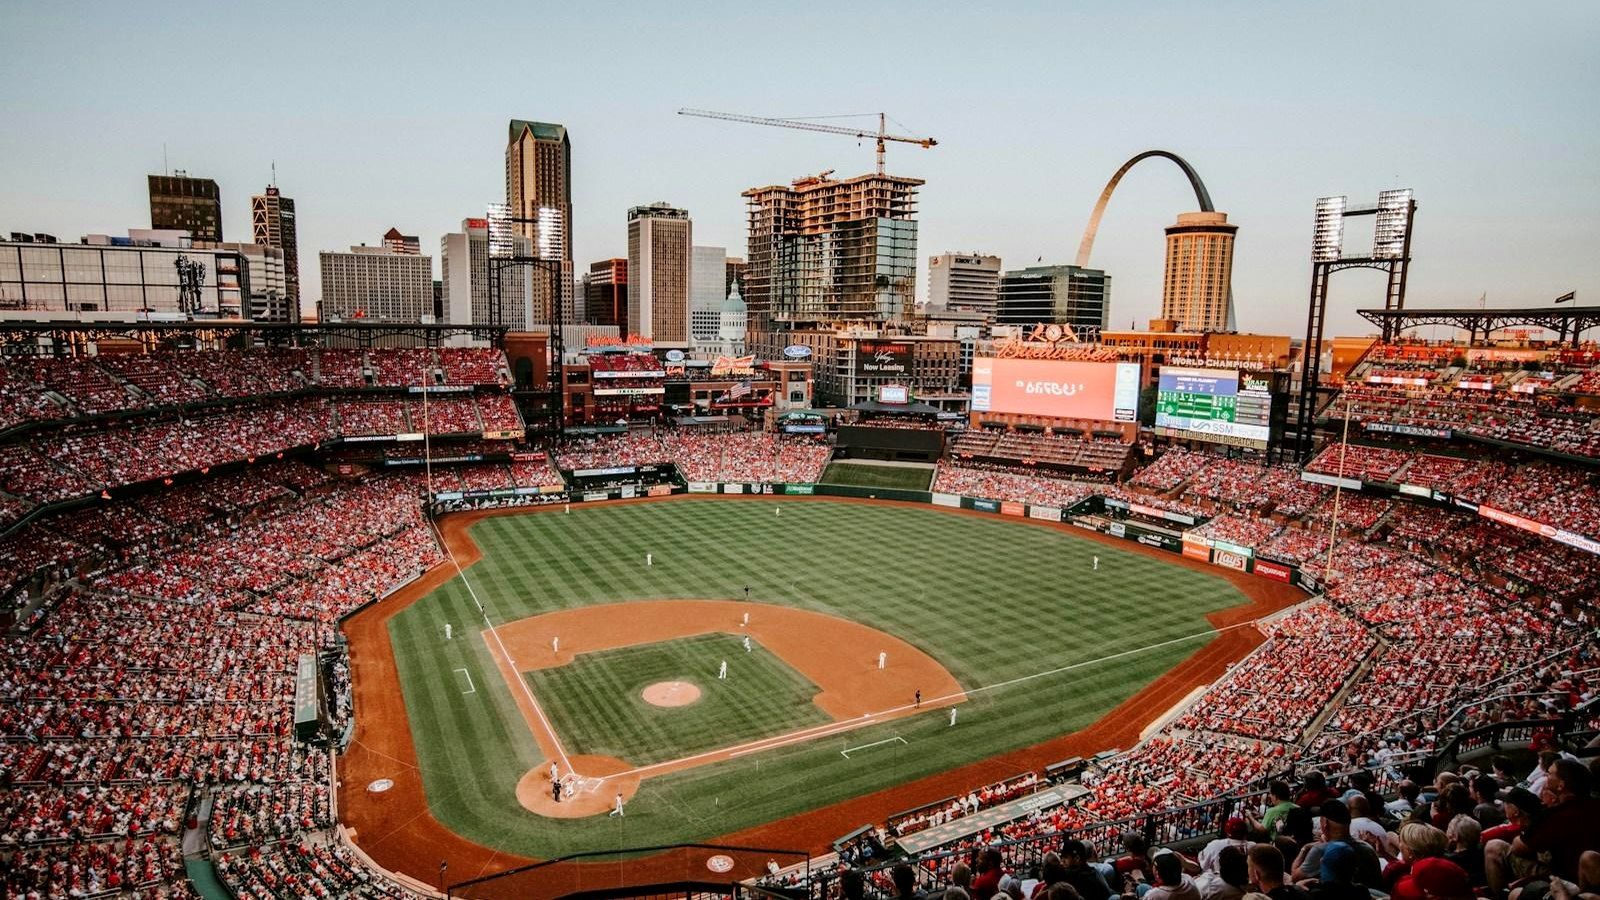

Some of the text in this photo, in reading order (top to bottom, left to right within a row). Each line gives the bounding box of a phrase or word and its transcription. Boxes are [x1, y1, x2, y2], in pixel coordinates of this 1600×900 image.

[863, 363, 905, 373] Now Leasing
[1172, 357, 1264, 369] WORLD CHAMPIONS
[1212, 423, 1233, 434] SSM
